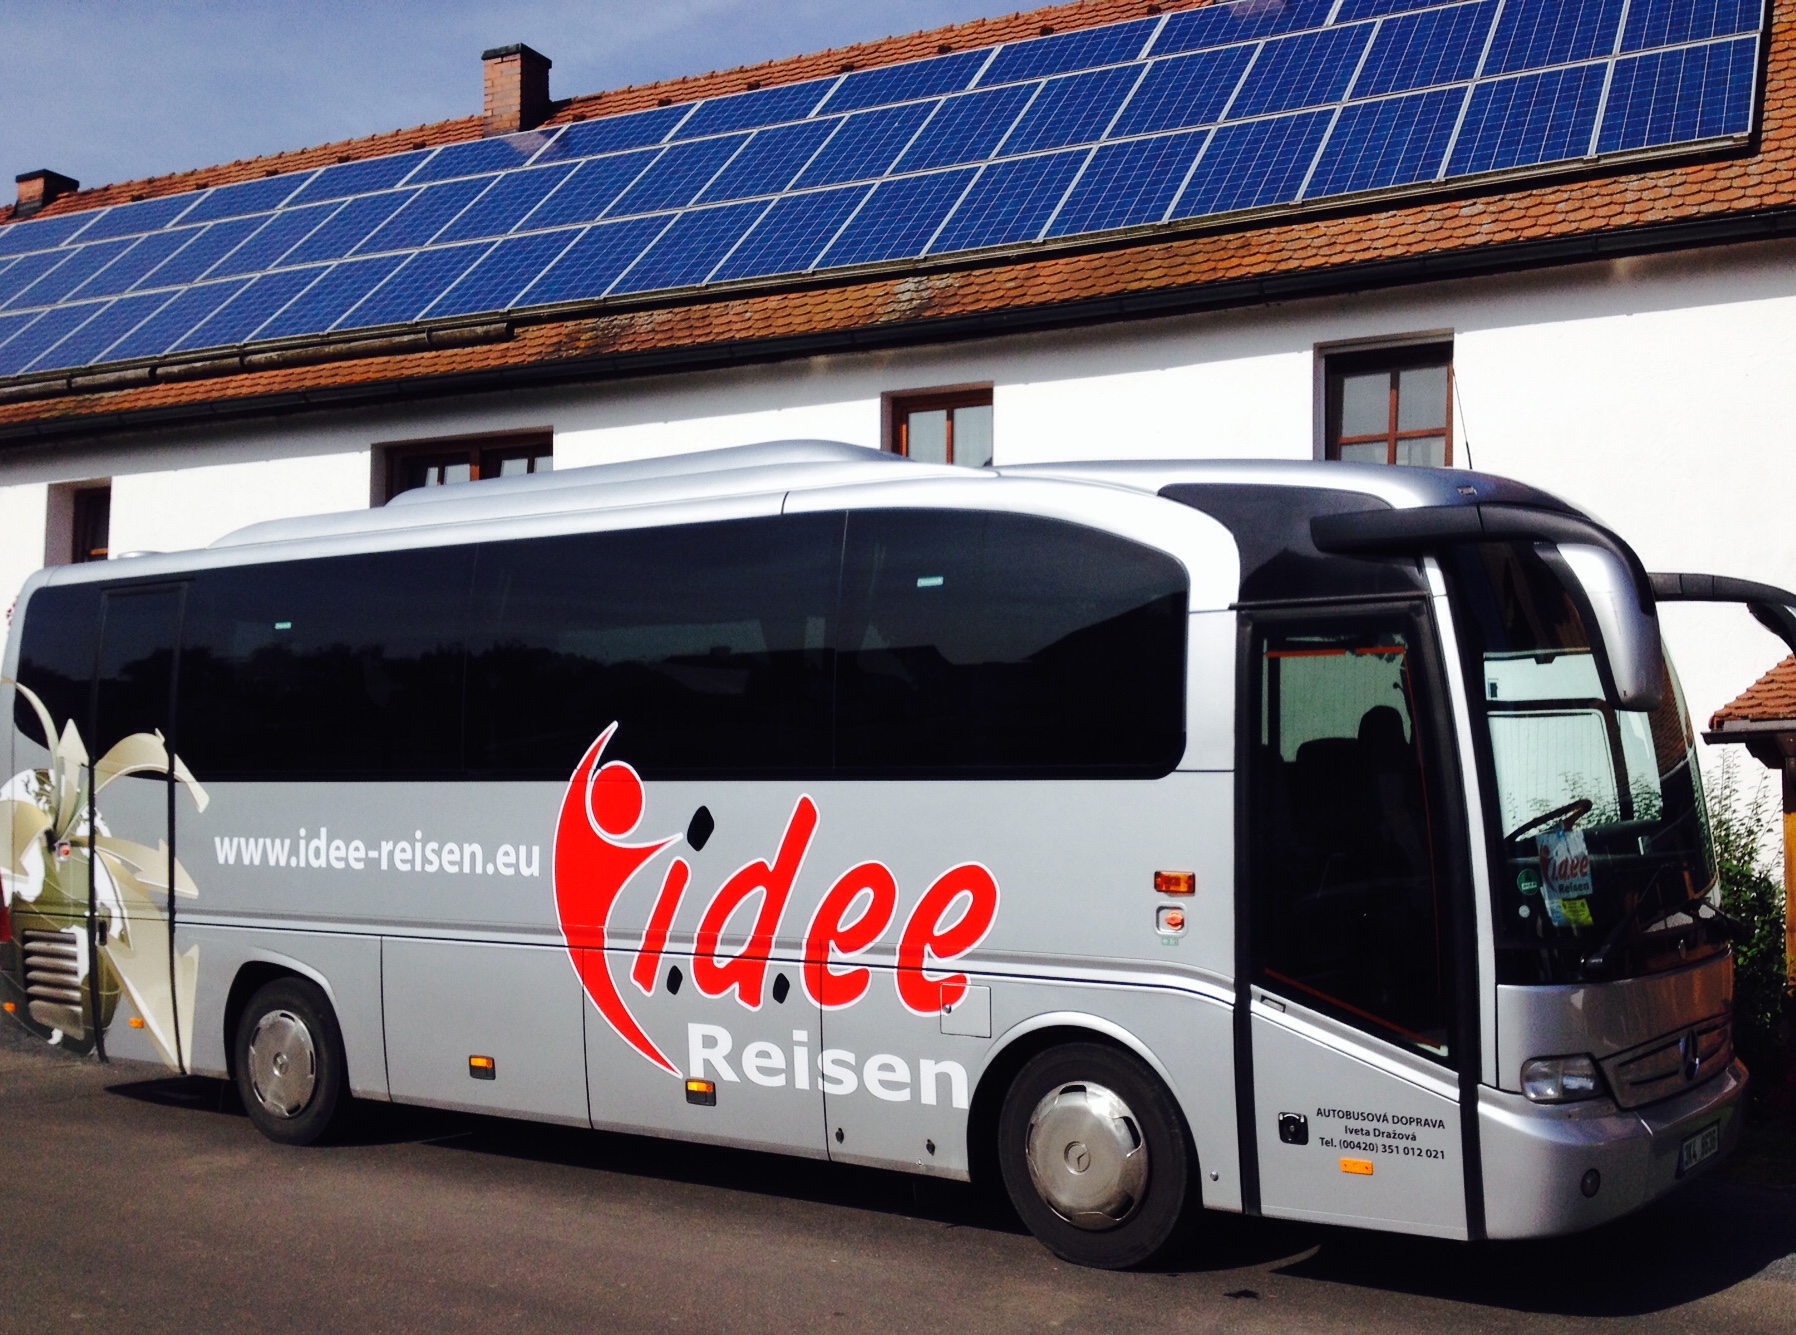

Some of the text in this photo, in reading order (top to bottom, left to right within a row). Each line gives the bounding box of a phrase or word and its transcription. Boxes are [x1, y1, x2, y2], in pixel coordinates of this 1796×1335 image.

[214, 827, 540, 877] www.idee-reisen.eu
[687, 1022, 969, 1109] Reisen
[1316, 1107, 1446, 1129] AUTOBUSOVÁ DOPRAVA
[1344, 1125, 1417, 1141] Iveta Dražová
[1319, 1137, 1445, 1160] Tel. (00420) 351 012 021
